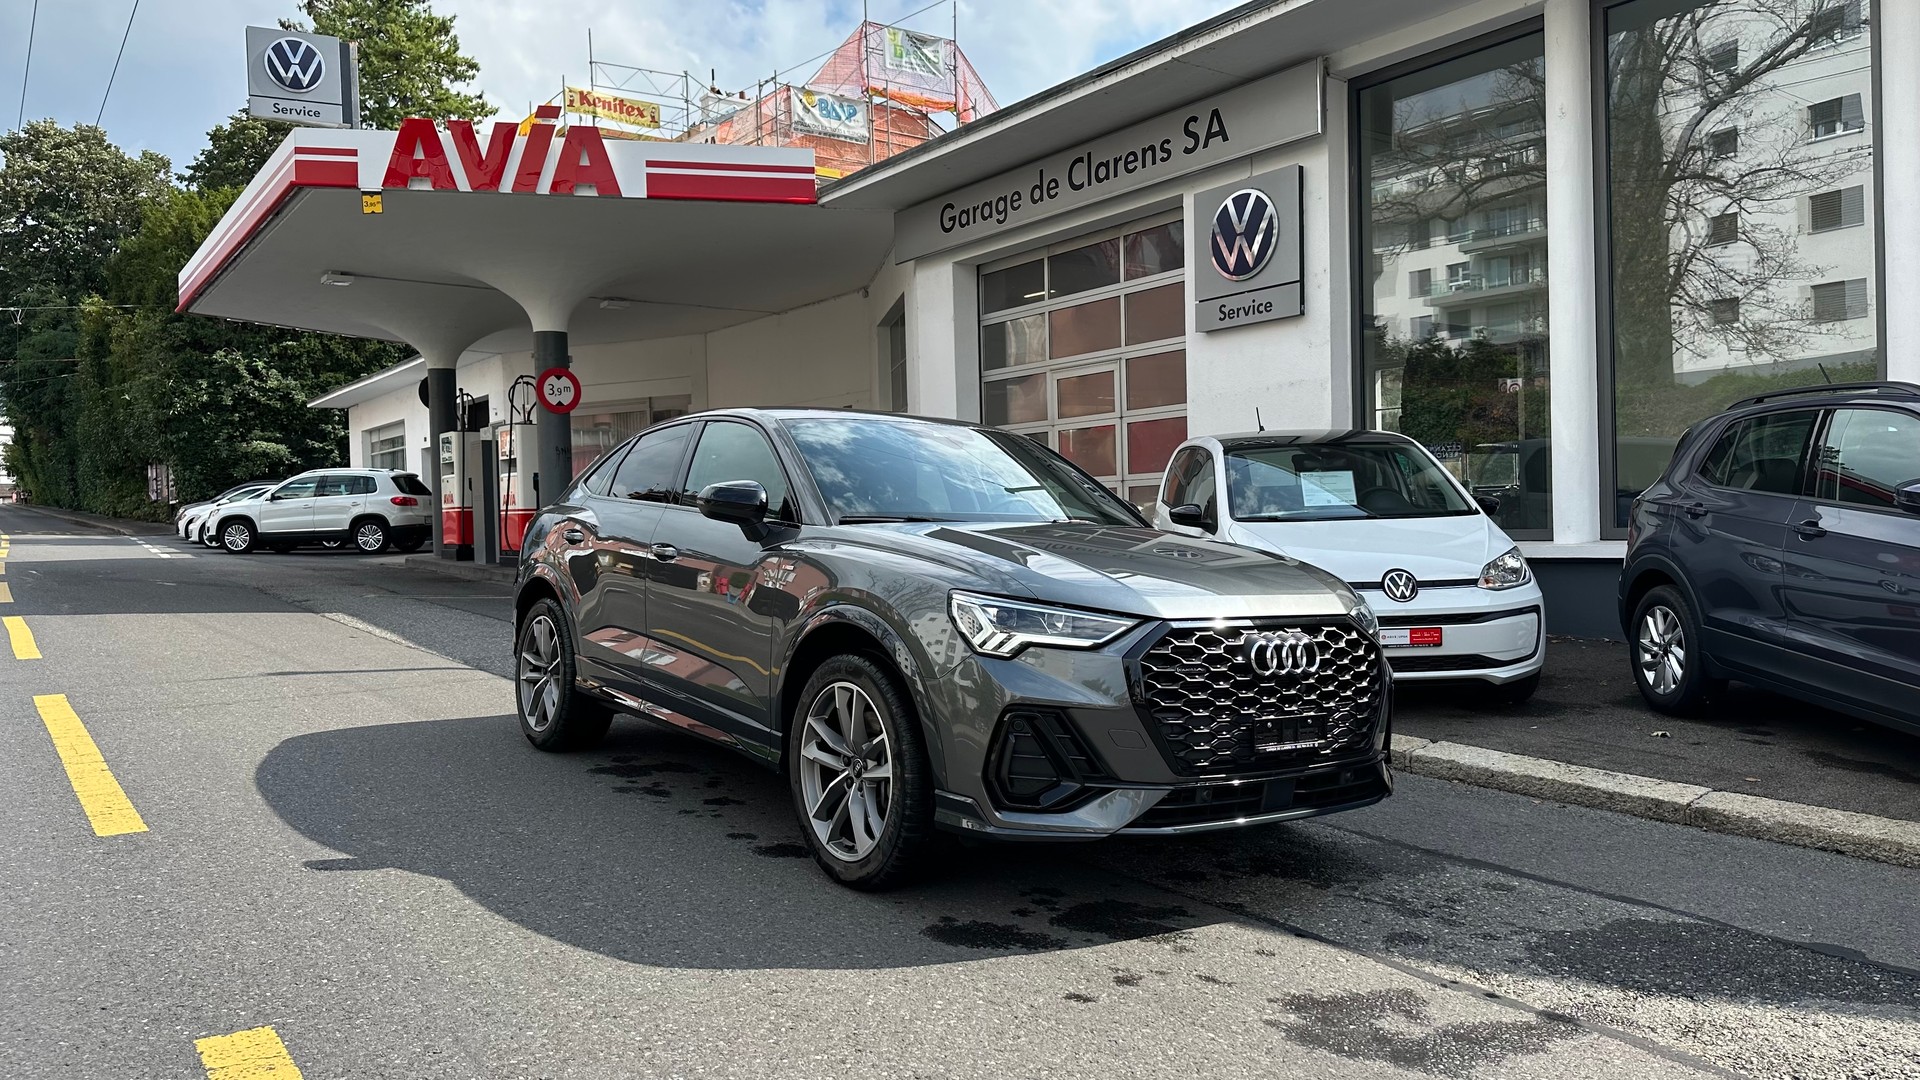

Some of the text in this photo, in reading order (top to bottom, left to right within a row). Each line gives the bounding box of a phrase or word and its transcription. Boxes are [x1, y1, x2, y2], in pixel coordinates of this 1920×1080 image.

[273, 102, 321, 118] Service
[578, 91, 648, 119] Kenitex
[939, 107, 1230, 234] Garage de Clarens SA
[1218, 299, 1273, 322] Service
